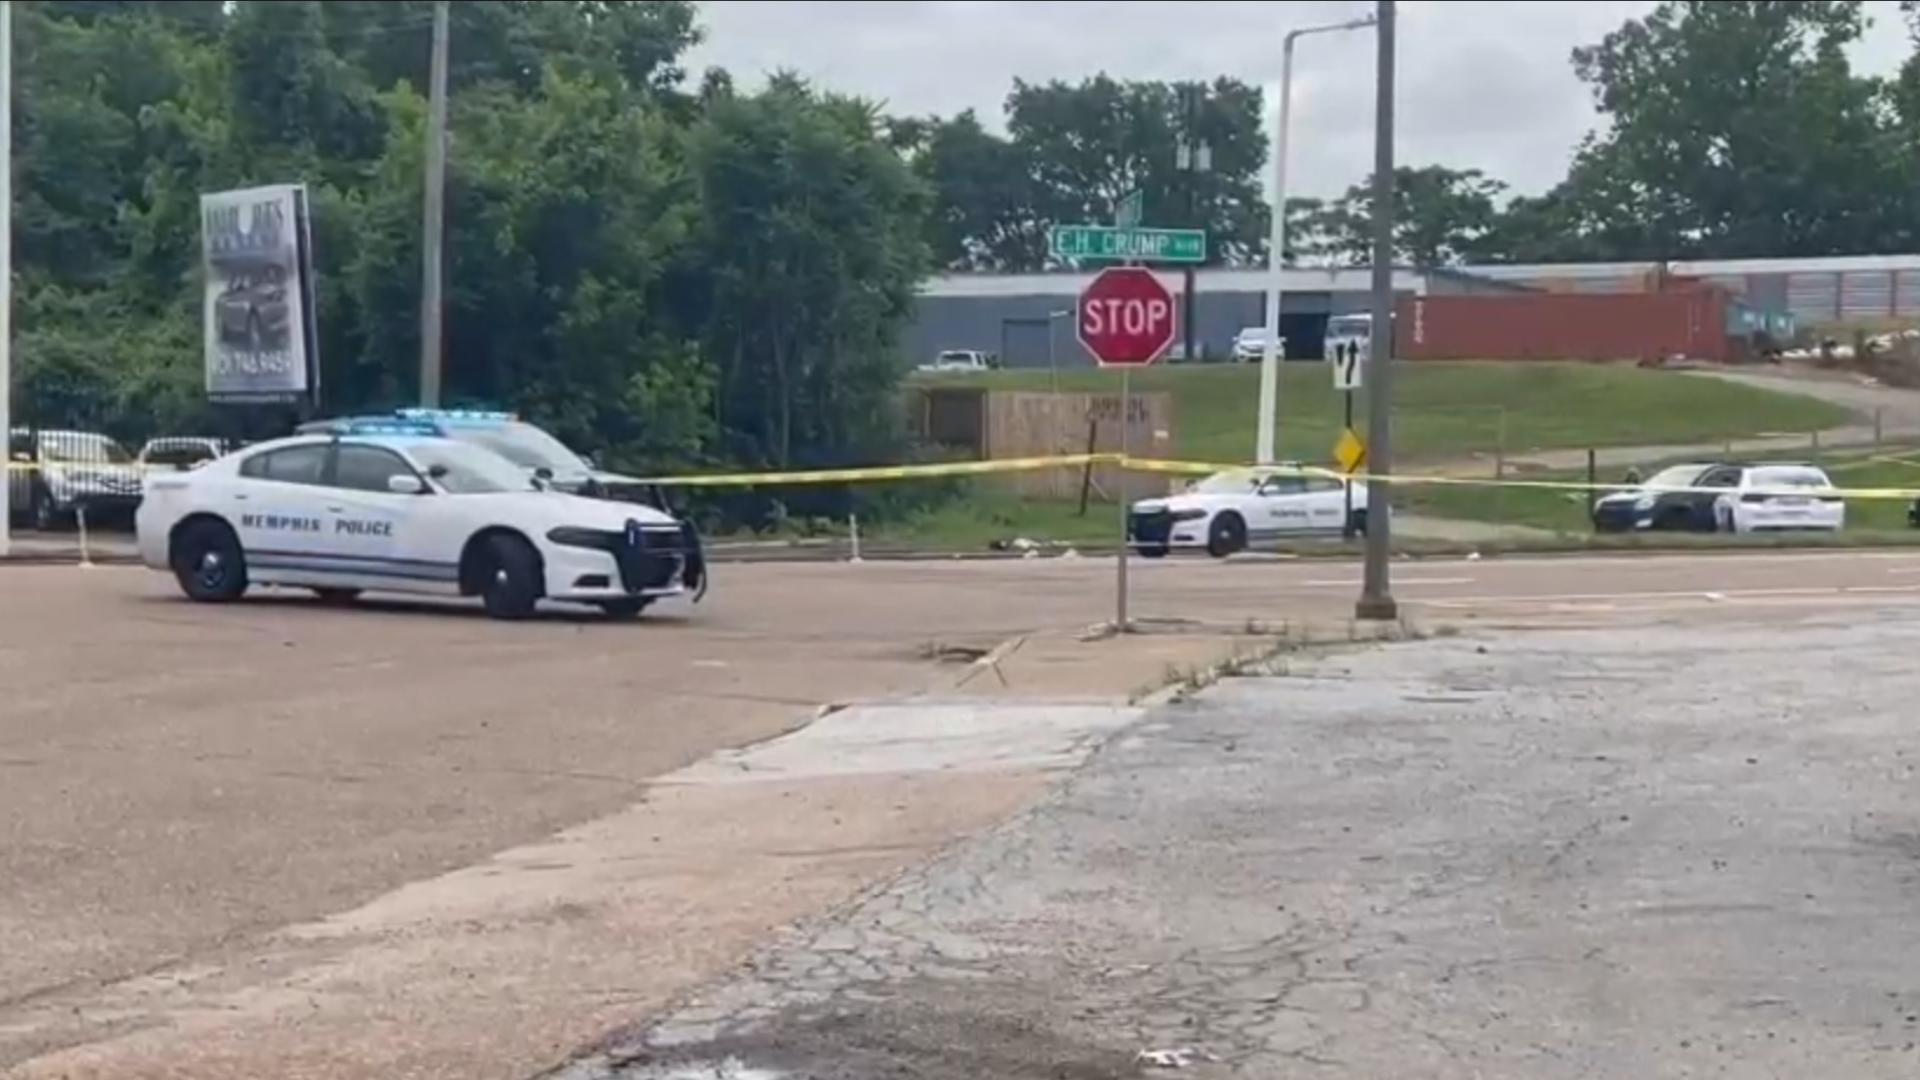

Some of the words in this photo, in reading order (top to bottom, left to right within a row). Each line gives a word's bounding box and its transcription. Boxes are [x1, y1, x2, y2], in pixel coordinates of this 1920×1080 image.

[1102, 232, 1169, 255] CRUMP
[1084, 299, 1167, 335] STOP
[241, 514, 320, 532] MEMPHIS
[335, 519, 392, 537] POLICE
